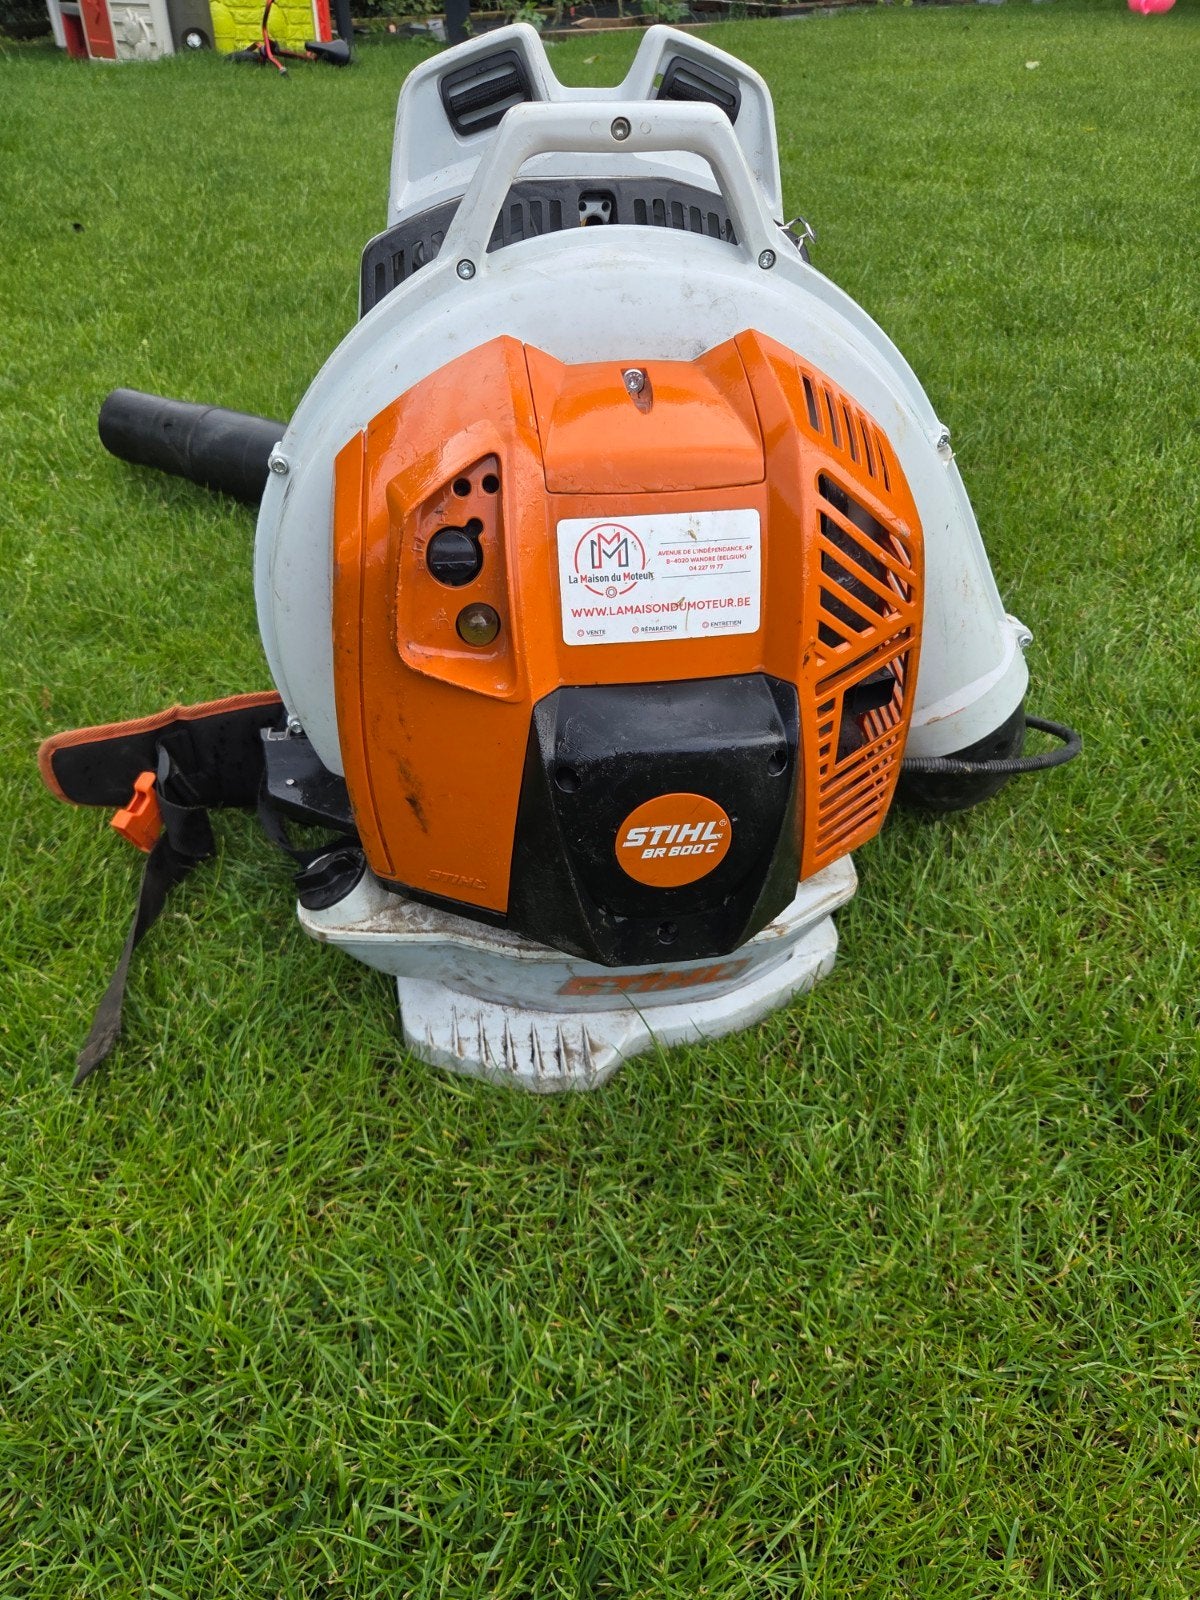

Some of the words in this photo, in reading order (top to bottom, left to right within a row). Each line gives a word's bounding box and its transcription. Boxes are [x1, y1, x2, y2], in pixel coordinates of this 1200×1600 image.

[569, 576, 579, 584] La
[580, 574, 610, 583] Maison
[611, 573, 622, 581] du
[623, 571, 654, 580] Moteur
[571, 597, 751, 618] WWW.LAMAISONDUMOTEUR.BE
[641, 847, 667, 859] BR
[668, 844, 704, 857] 800
[705, 842, 718, 853] C
